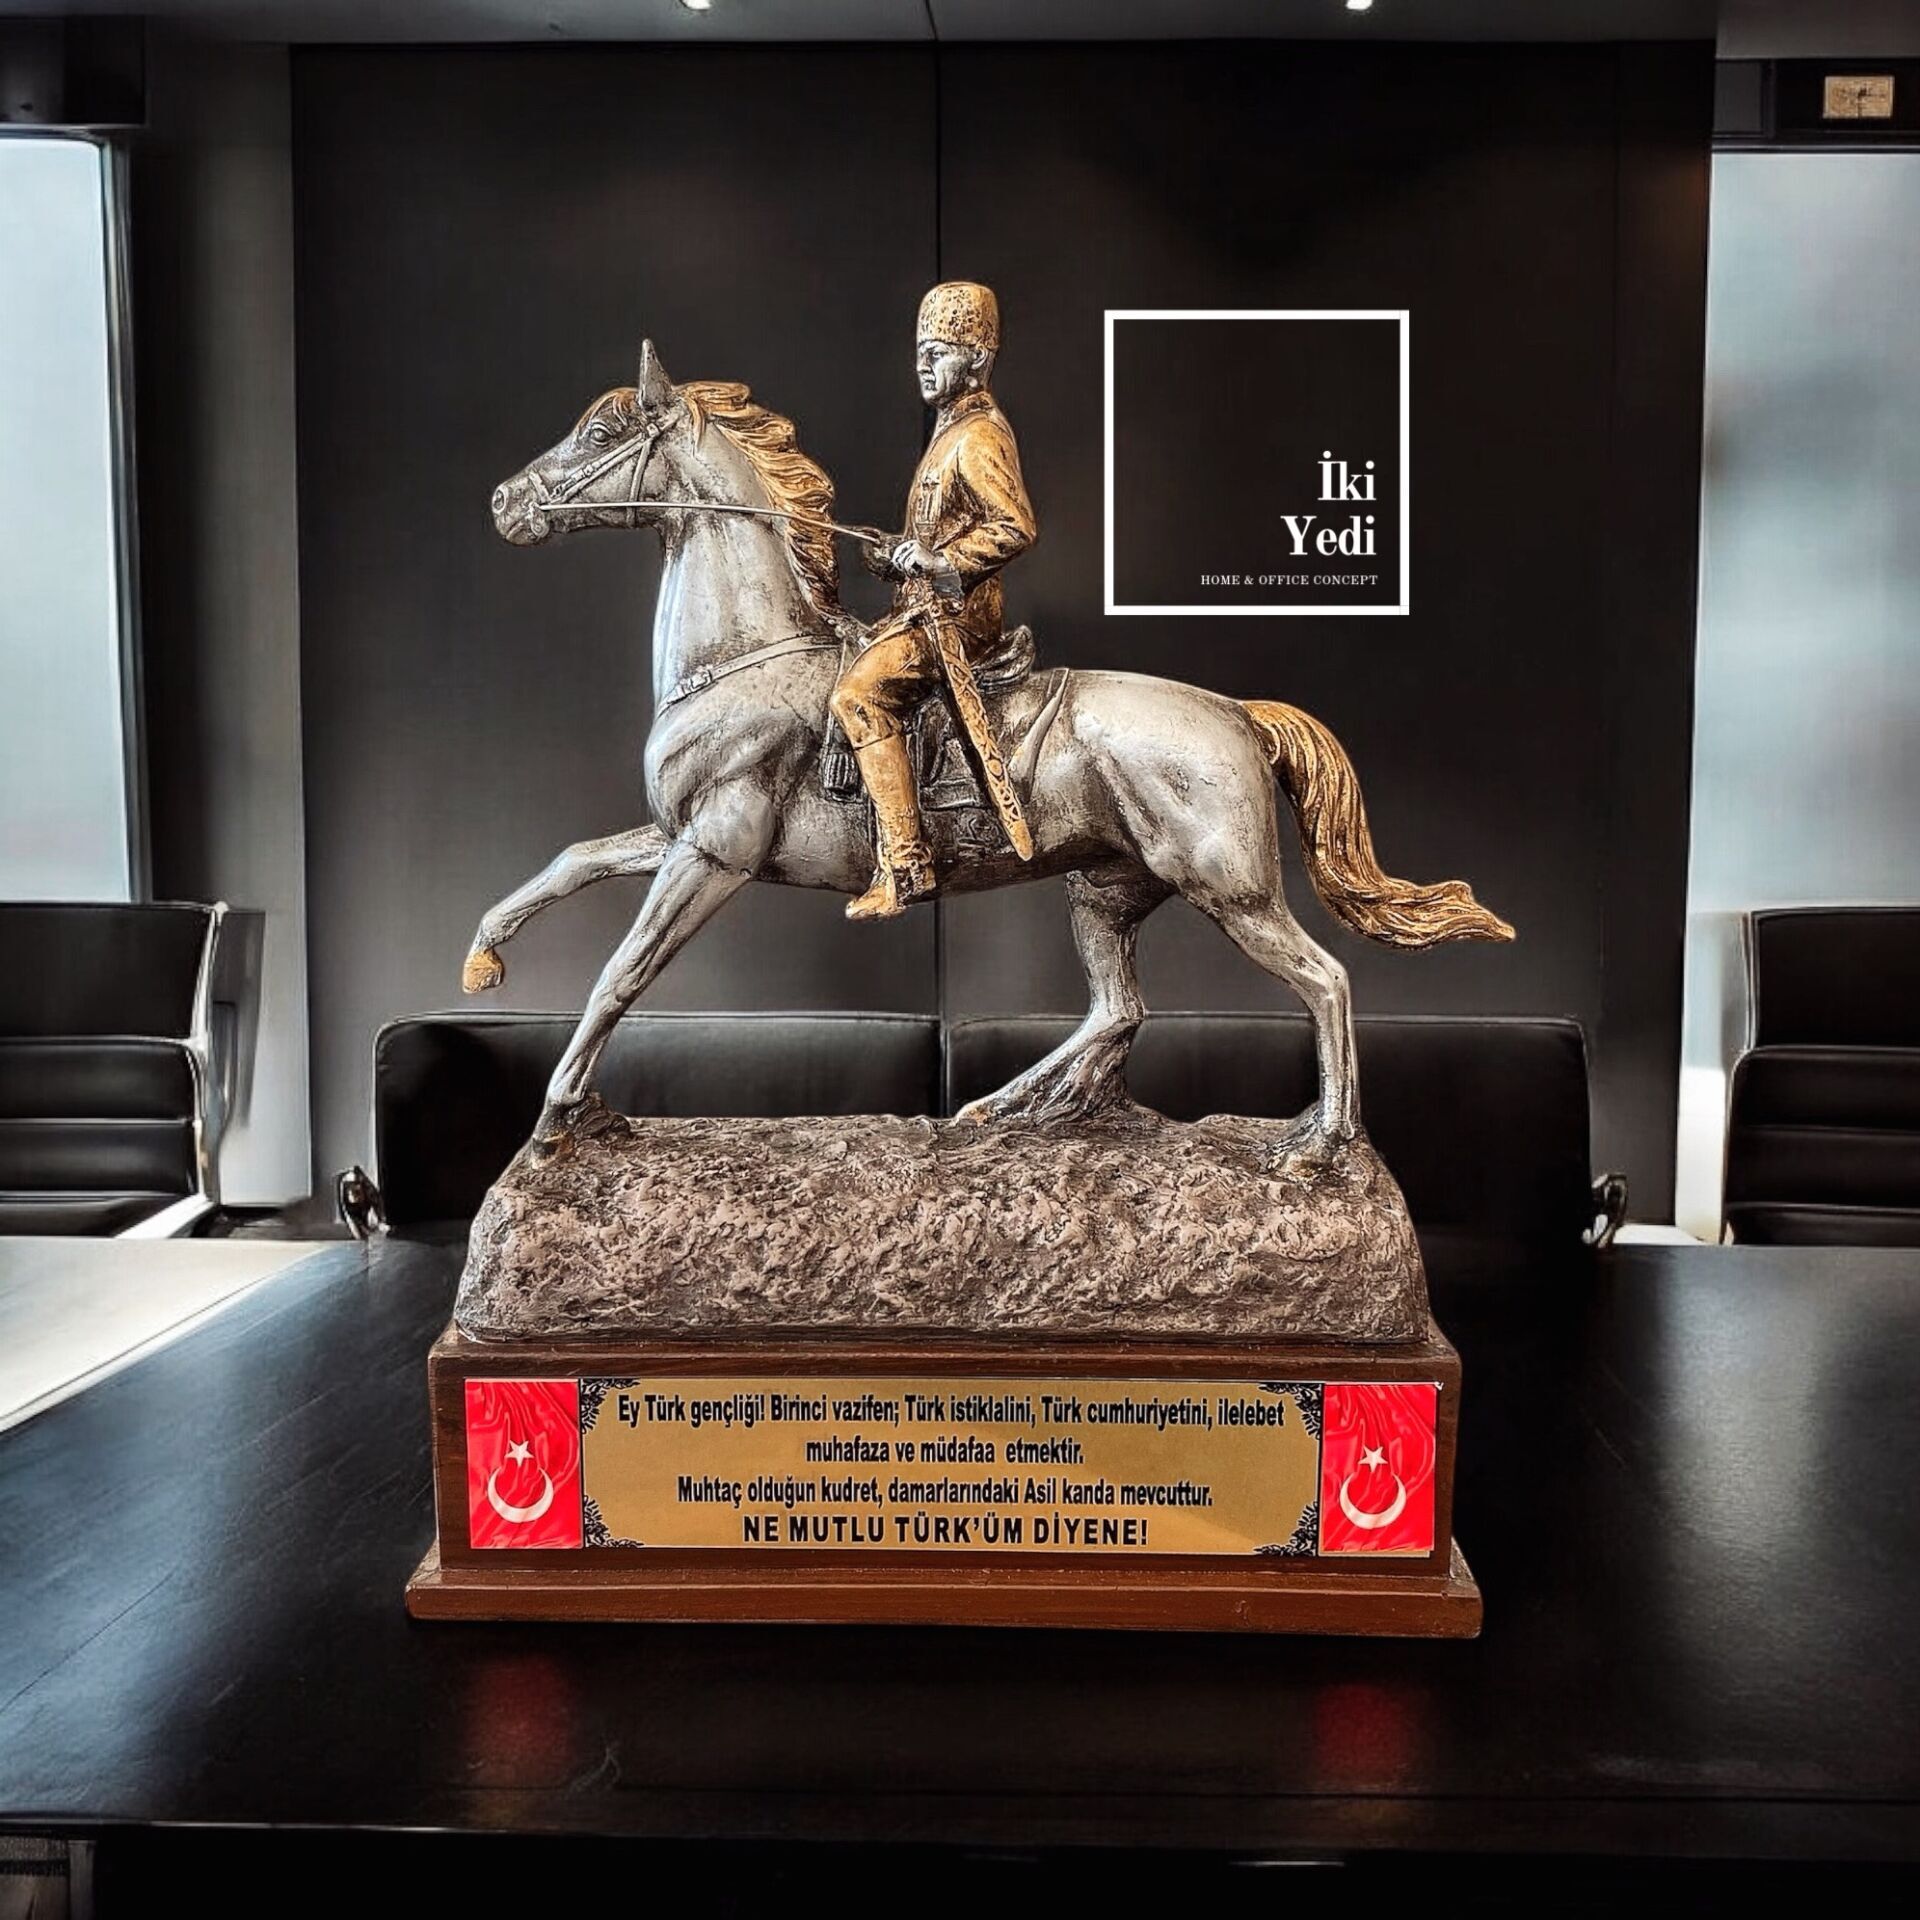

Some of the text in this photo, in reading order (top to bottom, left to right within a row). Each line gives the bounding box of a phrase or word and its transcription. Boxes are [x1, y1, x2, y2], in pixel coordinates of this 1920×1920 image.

[618, 1393, 1285, 1432] Ey Türk gençliği! Birinci vazifen; Türk istiklalini, Türk cumhuriyetini, ilelebet
[806, 1435, 1084, 1465] muhafaza ve müdafaa etmektir.
[678, 1475, 1213, 1510] Muhtaç olduğun kudret, damarlarındaki Asil kanda mevcuttur.
[743, 1515, 779, 1542] NE
[789, 1515, 884, 1543] MUTLU
[1033, 1511, 1148, 1546] DİYENE!
